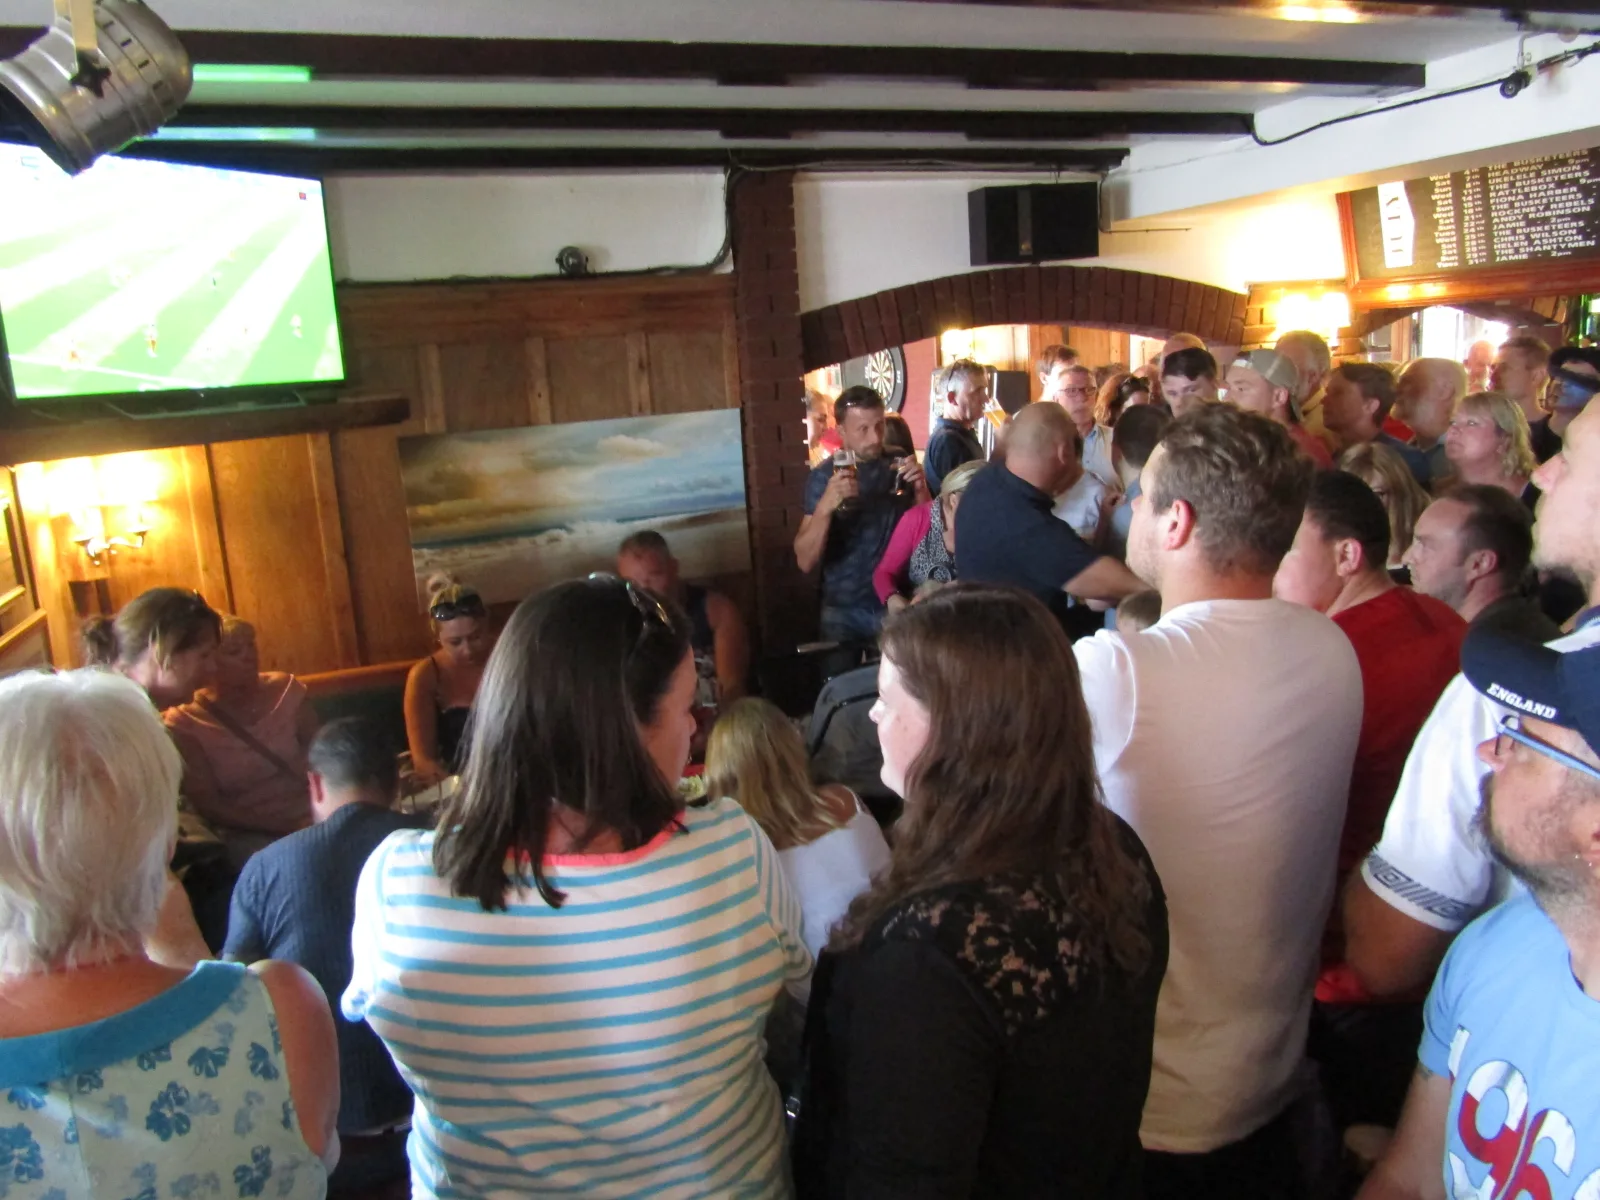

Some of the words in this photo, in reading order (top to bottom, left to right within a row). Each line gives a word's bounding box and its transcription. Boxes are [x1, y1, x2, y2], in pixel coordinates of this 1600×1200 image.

[1488, 163, 1544, 178] HEADWAY
[1488, 171, 1536, 184] UKELELE
[1540, 164, 1581, 176] SIMON
[1490, 183, 1510, 191] THE
[1516, 170, 1590, 187] BUSKETEERS
[1489, 182, 1556, 198] RATTLEBOX
[1490, 194, 1524, 204] FIONA
[1529, 186, 1577, 198] HARBER
[1491, 206, 1545, 218] ROCKNEY
[1550, 198, 1595, 210] REBELS
[1514, 192, 1582, 208] BUSKETEERS
[1492, 214, 1524, 224] ANDY
[1528, 206, 1590, 218] ROBINSON
[1492, 220, 1526, 230] JAMIE
[1516, 220, 1584, 234] BUSKETEERS
[1494, 234, 1526, 243] CHRIS
[1530, 228, 1577, 239] WILSON
[1494, 240, 1528, 250] HELEN
[1533, 234, 1582, 246] ASHTON
[1519, 240, 1596, 254] SHANTYMEN
[1496, 253, 1529, 262] JAMIE
[1486, 682, 1557, 719] ENGLAND
